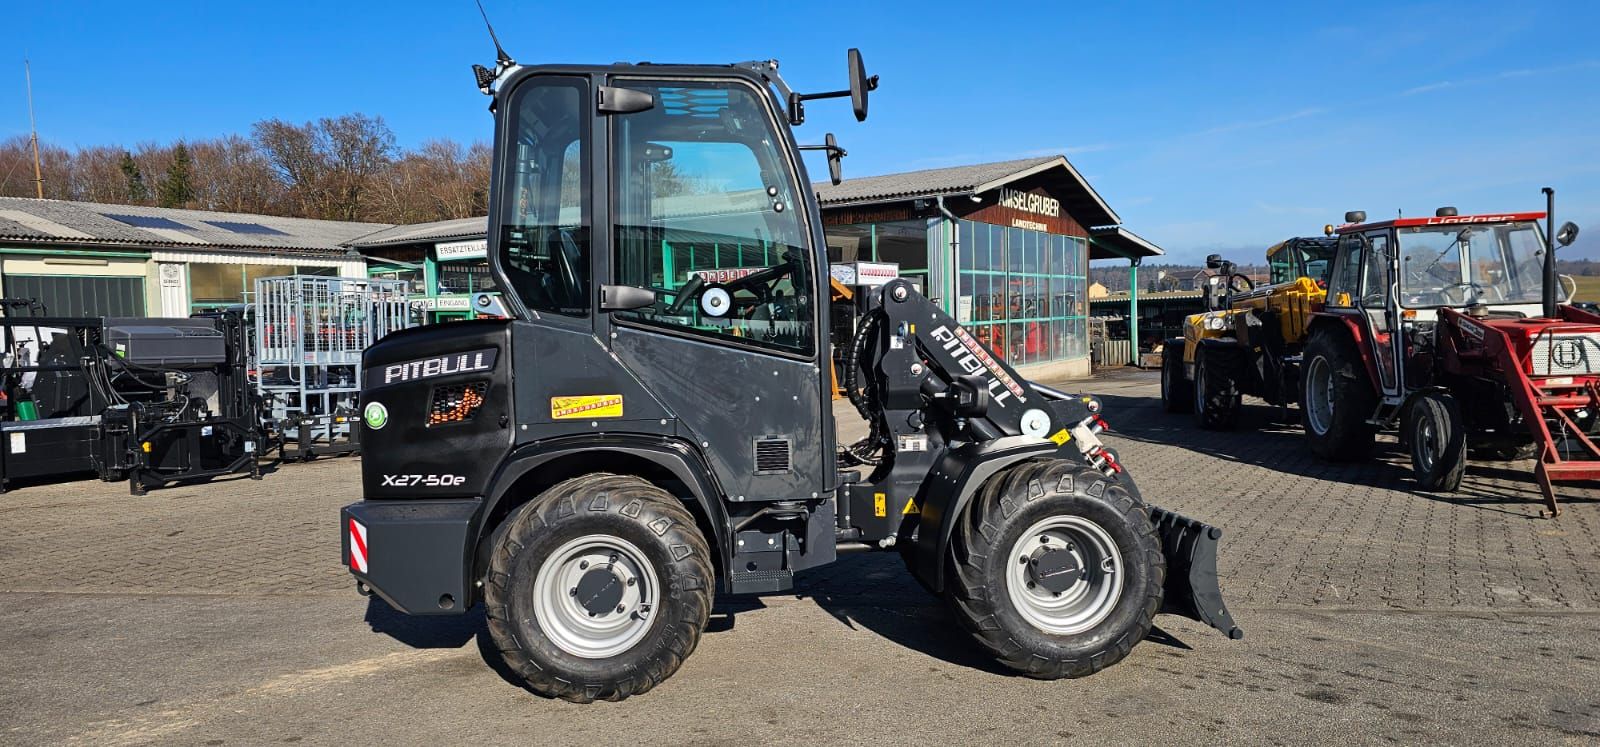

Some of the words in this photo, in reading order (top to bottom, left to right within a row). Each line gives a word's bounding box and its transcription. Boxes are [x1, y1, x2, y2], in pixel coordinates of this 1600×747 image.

[998, 186, 1060, 218] AMSELGRUBER
[1012, 218, 1048, 232] LANDTECHNIK
[1427, 216, 1517, 225] Lindner
[384, 352, 489, 384] PITBULL
[381, 474, 466, 486] X27-50e
